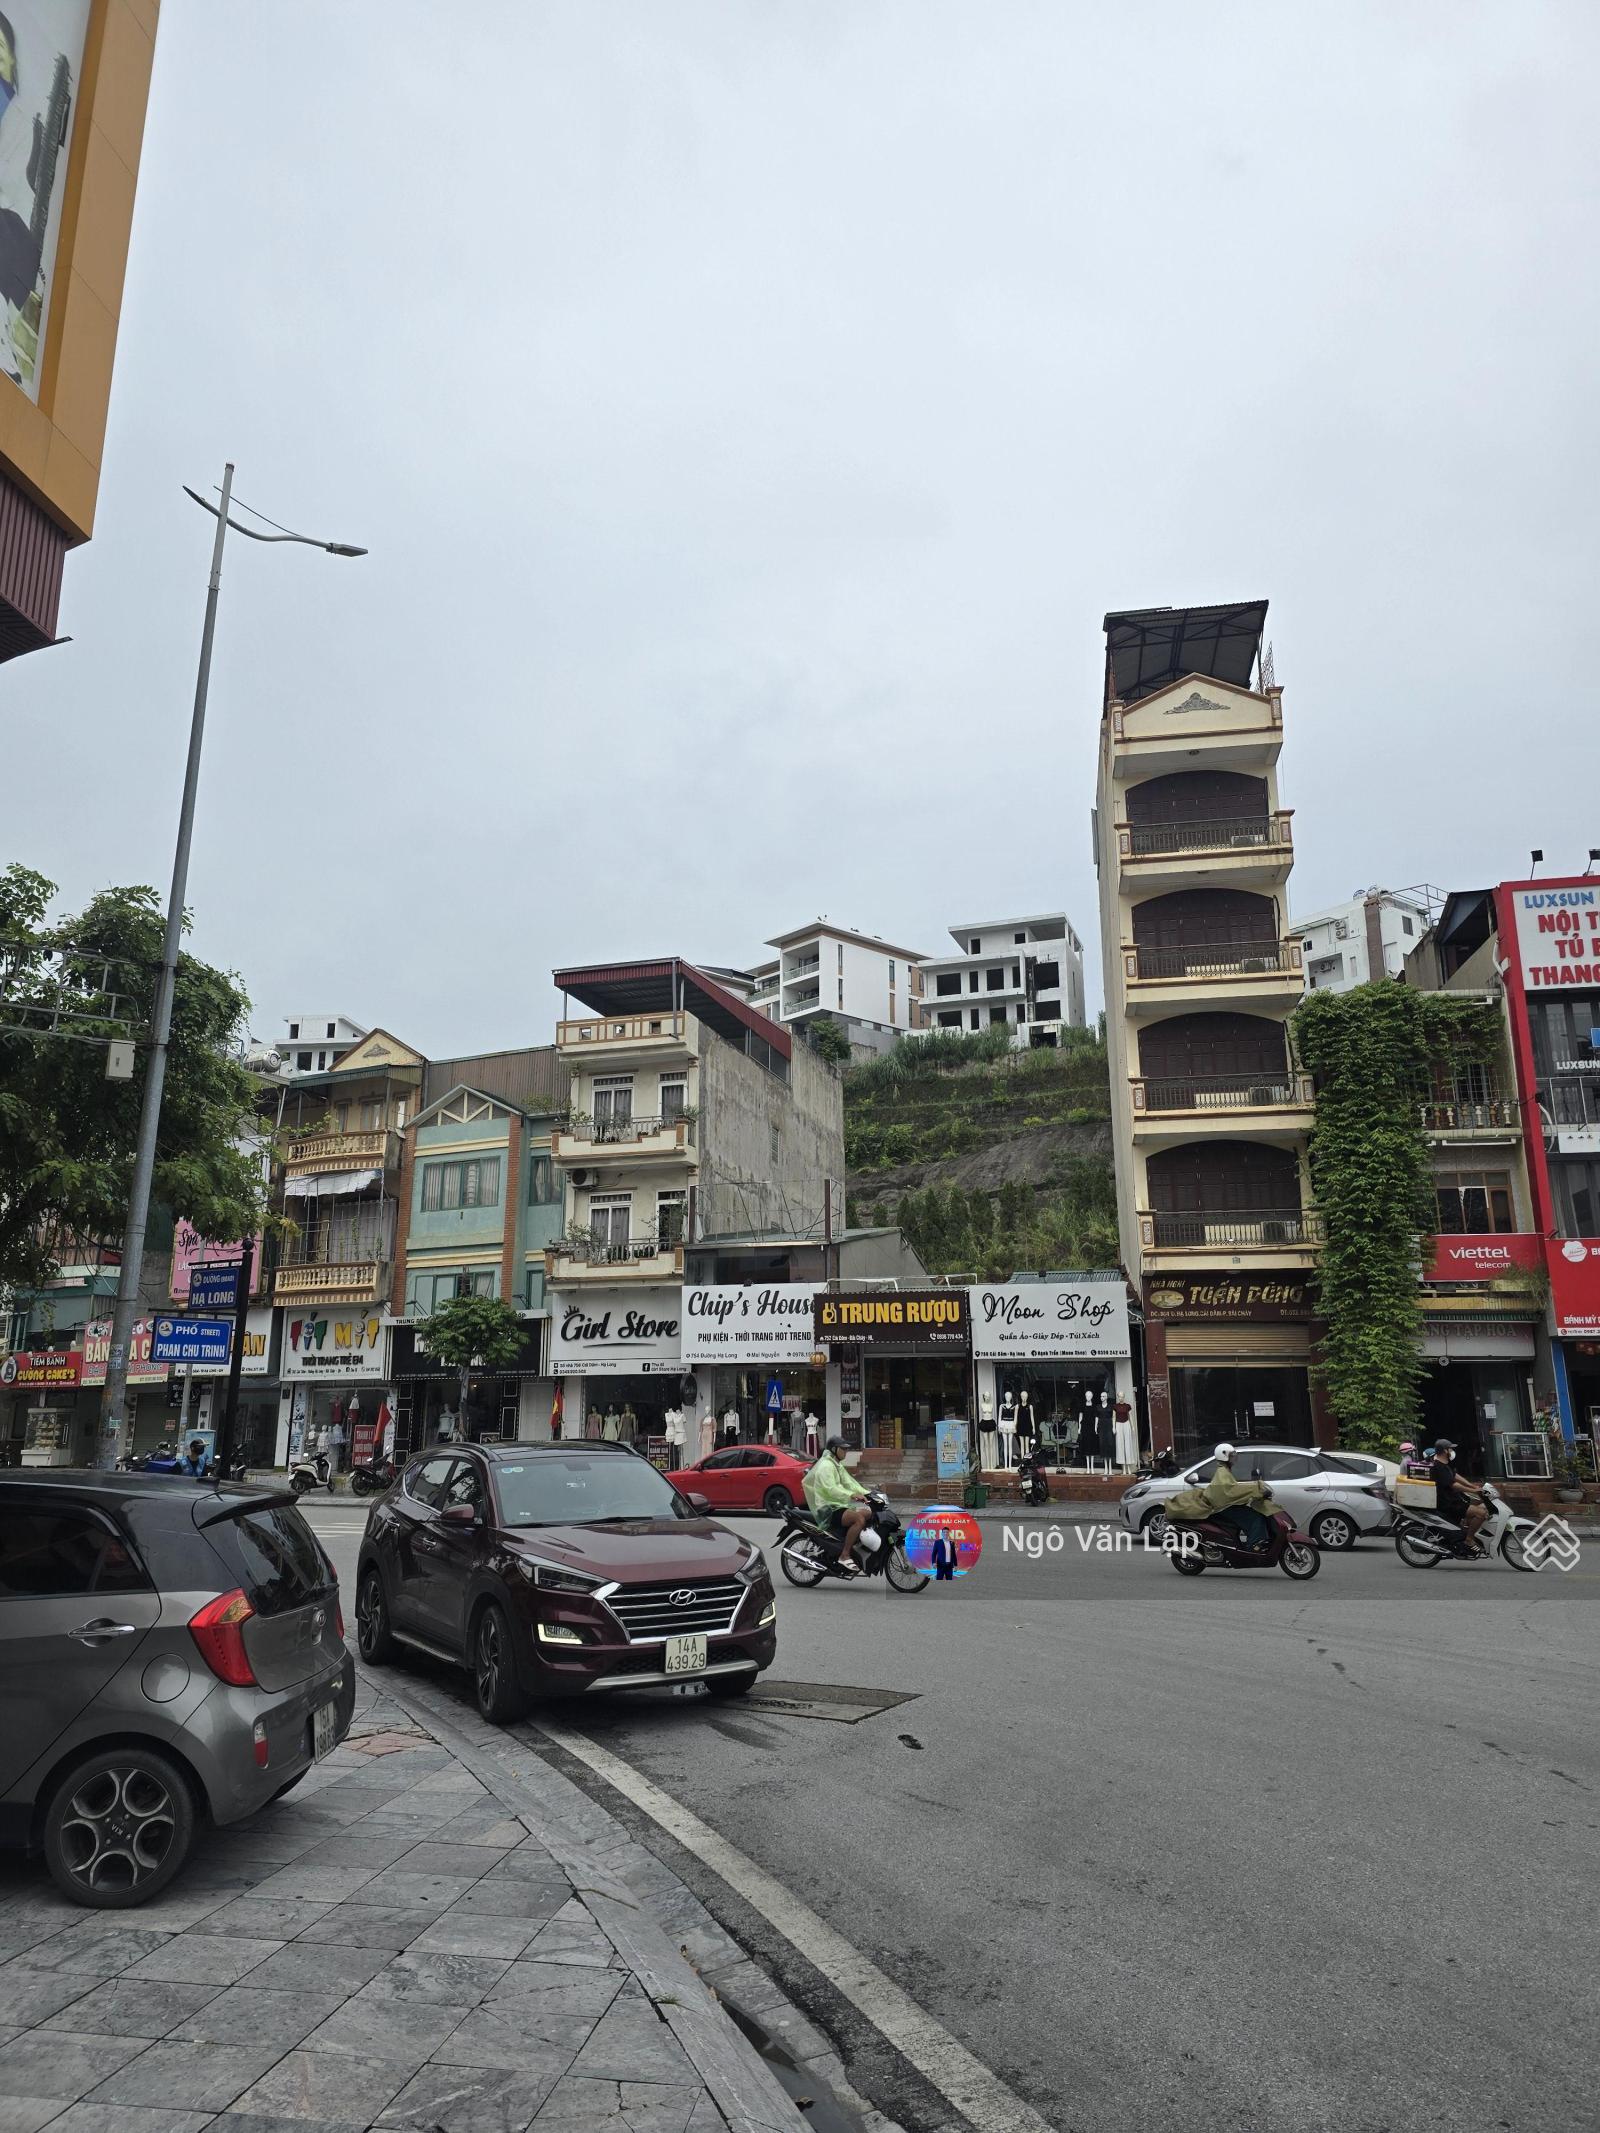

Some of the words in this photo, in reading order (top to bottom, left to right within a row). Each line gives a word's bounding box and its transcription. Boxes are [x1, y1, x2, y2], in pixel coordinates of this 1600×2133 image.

[1524, 891, 1594, 908] LUXSUN
[1538, 909, 1580, 935] NỘI
[1586, 911, 1600, 930] T
[1555, 933, 1584, 958] TỦ
[1449, 1246, 1511, 1259] viettel
[1475, 1261, 1511, 1269] telecom
[192, 1292, 205, 1306] HẠ
[207, 1291, 234, 1304] LONG
[1189, 1280, 1242, 1306] TUẤN
[1246, 1281, 1304, 1304] DŨNG
[688, 1290, 749, 1325] Chip's
[839, 1302, 903, 1324] TRUNG
[906, 1300, 960, 1327] RƯỢU
[982, 1293, 1044, 1325] Moon
[1057, 1294, 1114, 1326] Shop
[560, 1311, 610, 1341] Girl
[617, 1310, 679, 1338] Store
[1564, 1314, 1585, 1324] BÁNH
[175, 1323, 199, 1335] PHỐ
[999, 1332, 1017, 1340] Quần
[1050, 1331, 1064, 1341] Dép
[698, 1333, 711, 1344] PHỤ
[713, 1332, 729, 1344] KIỆN
[735, 1331, 750, 1342] THỜI
[751, 1331, 773, 1341] TRANG
[774, 1331, 789, 1340] HOT
[790, 1331, 812, 1341] TREND
[86, 1338, 111, 1363] BÁN
[156, 1343, 180, 1357] PHAN
[182, 1344, 200, 1357] CHU
[201, 1345, 226, 1358] TRINH
[725, 1352, 737, 1360] Long
[46, 1353, 66, 1365] BÁNH
[317, 1356, 339, 1366] TRANG
[352, 1355, 364, 1365] EM
[46, 1368, 76, 1380] CAKE'S
[677, 1637, 697, 1654] 14A
[667, 1652, 705, 1671] 439.29
